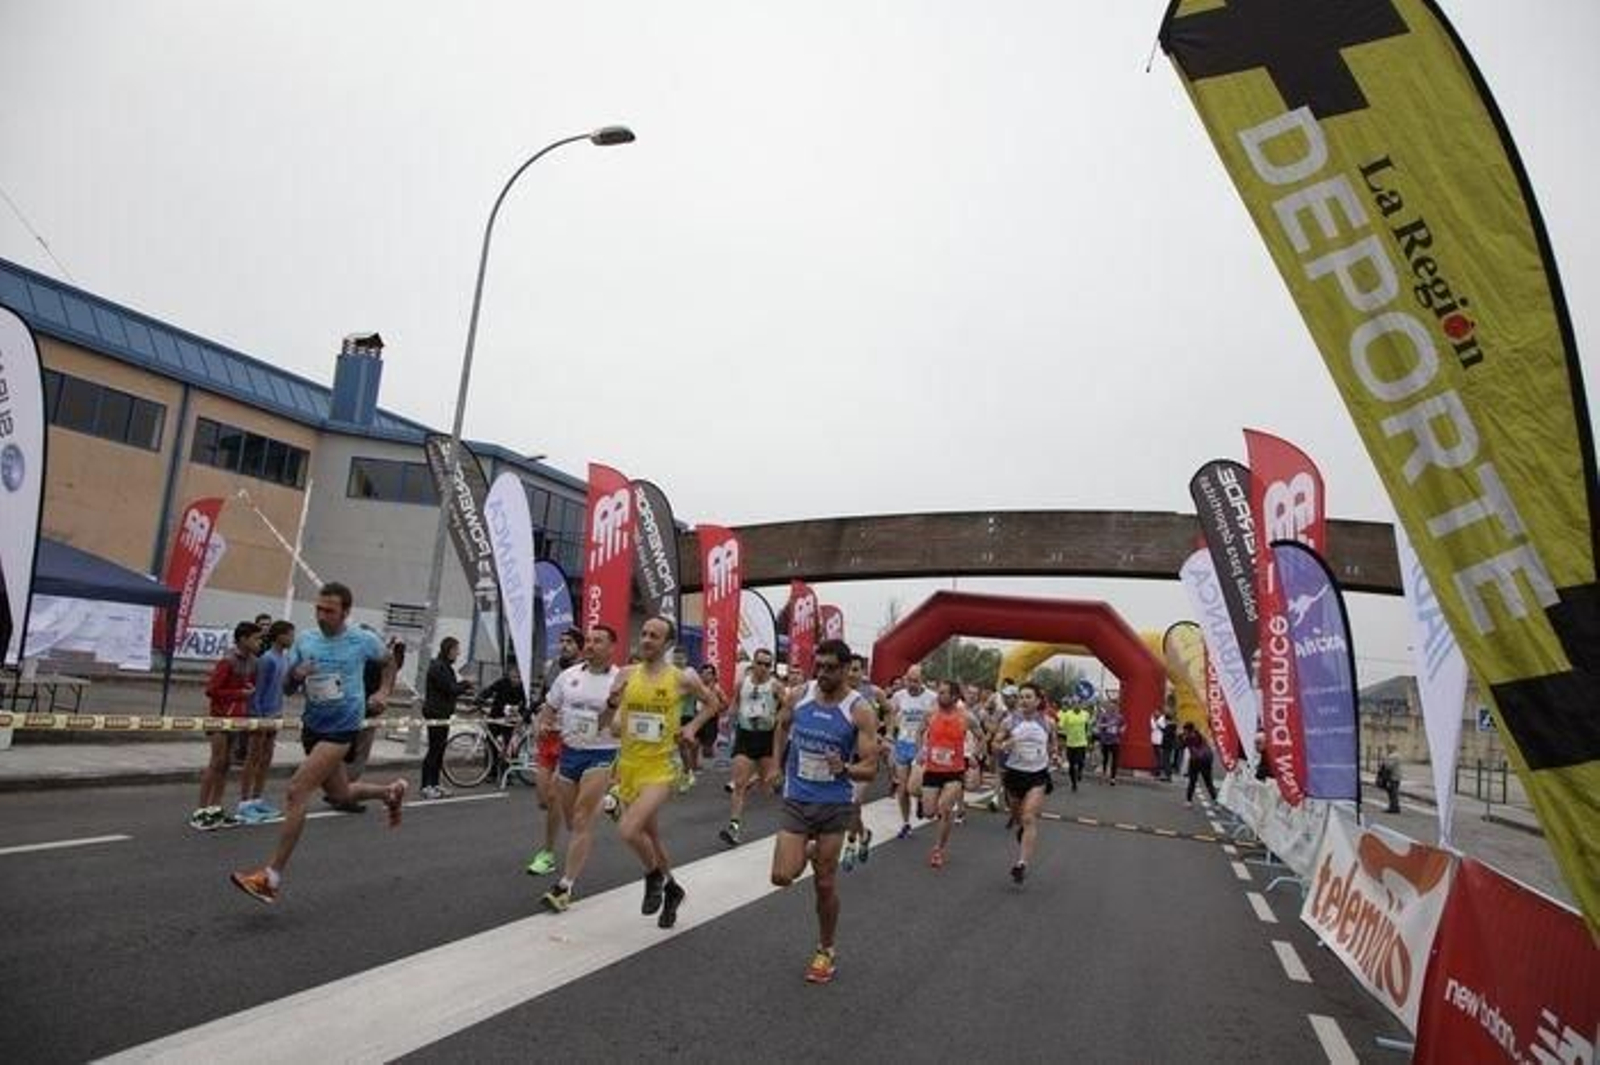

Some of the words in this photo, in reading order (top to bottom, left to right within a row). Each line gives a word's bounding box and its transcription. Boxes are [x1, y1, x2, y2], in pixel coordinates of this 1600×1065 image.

[1237, 104, 1561, 636] DEPORTE
[1359, 154, 1403, 218] La
[1393, 217, 1485, 370] Región
[1444, 977, 1483, 1018] new
